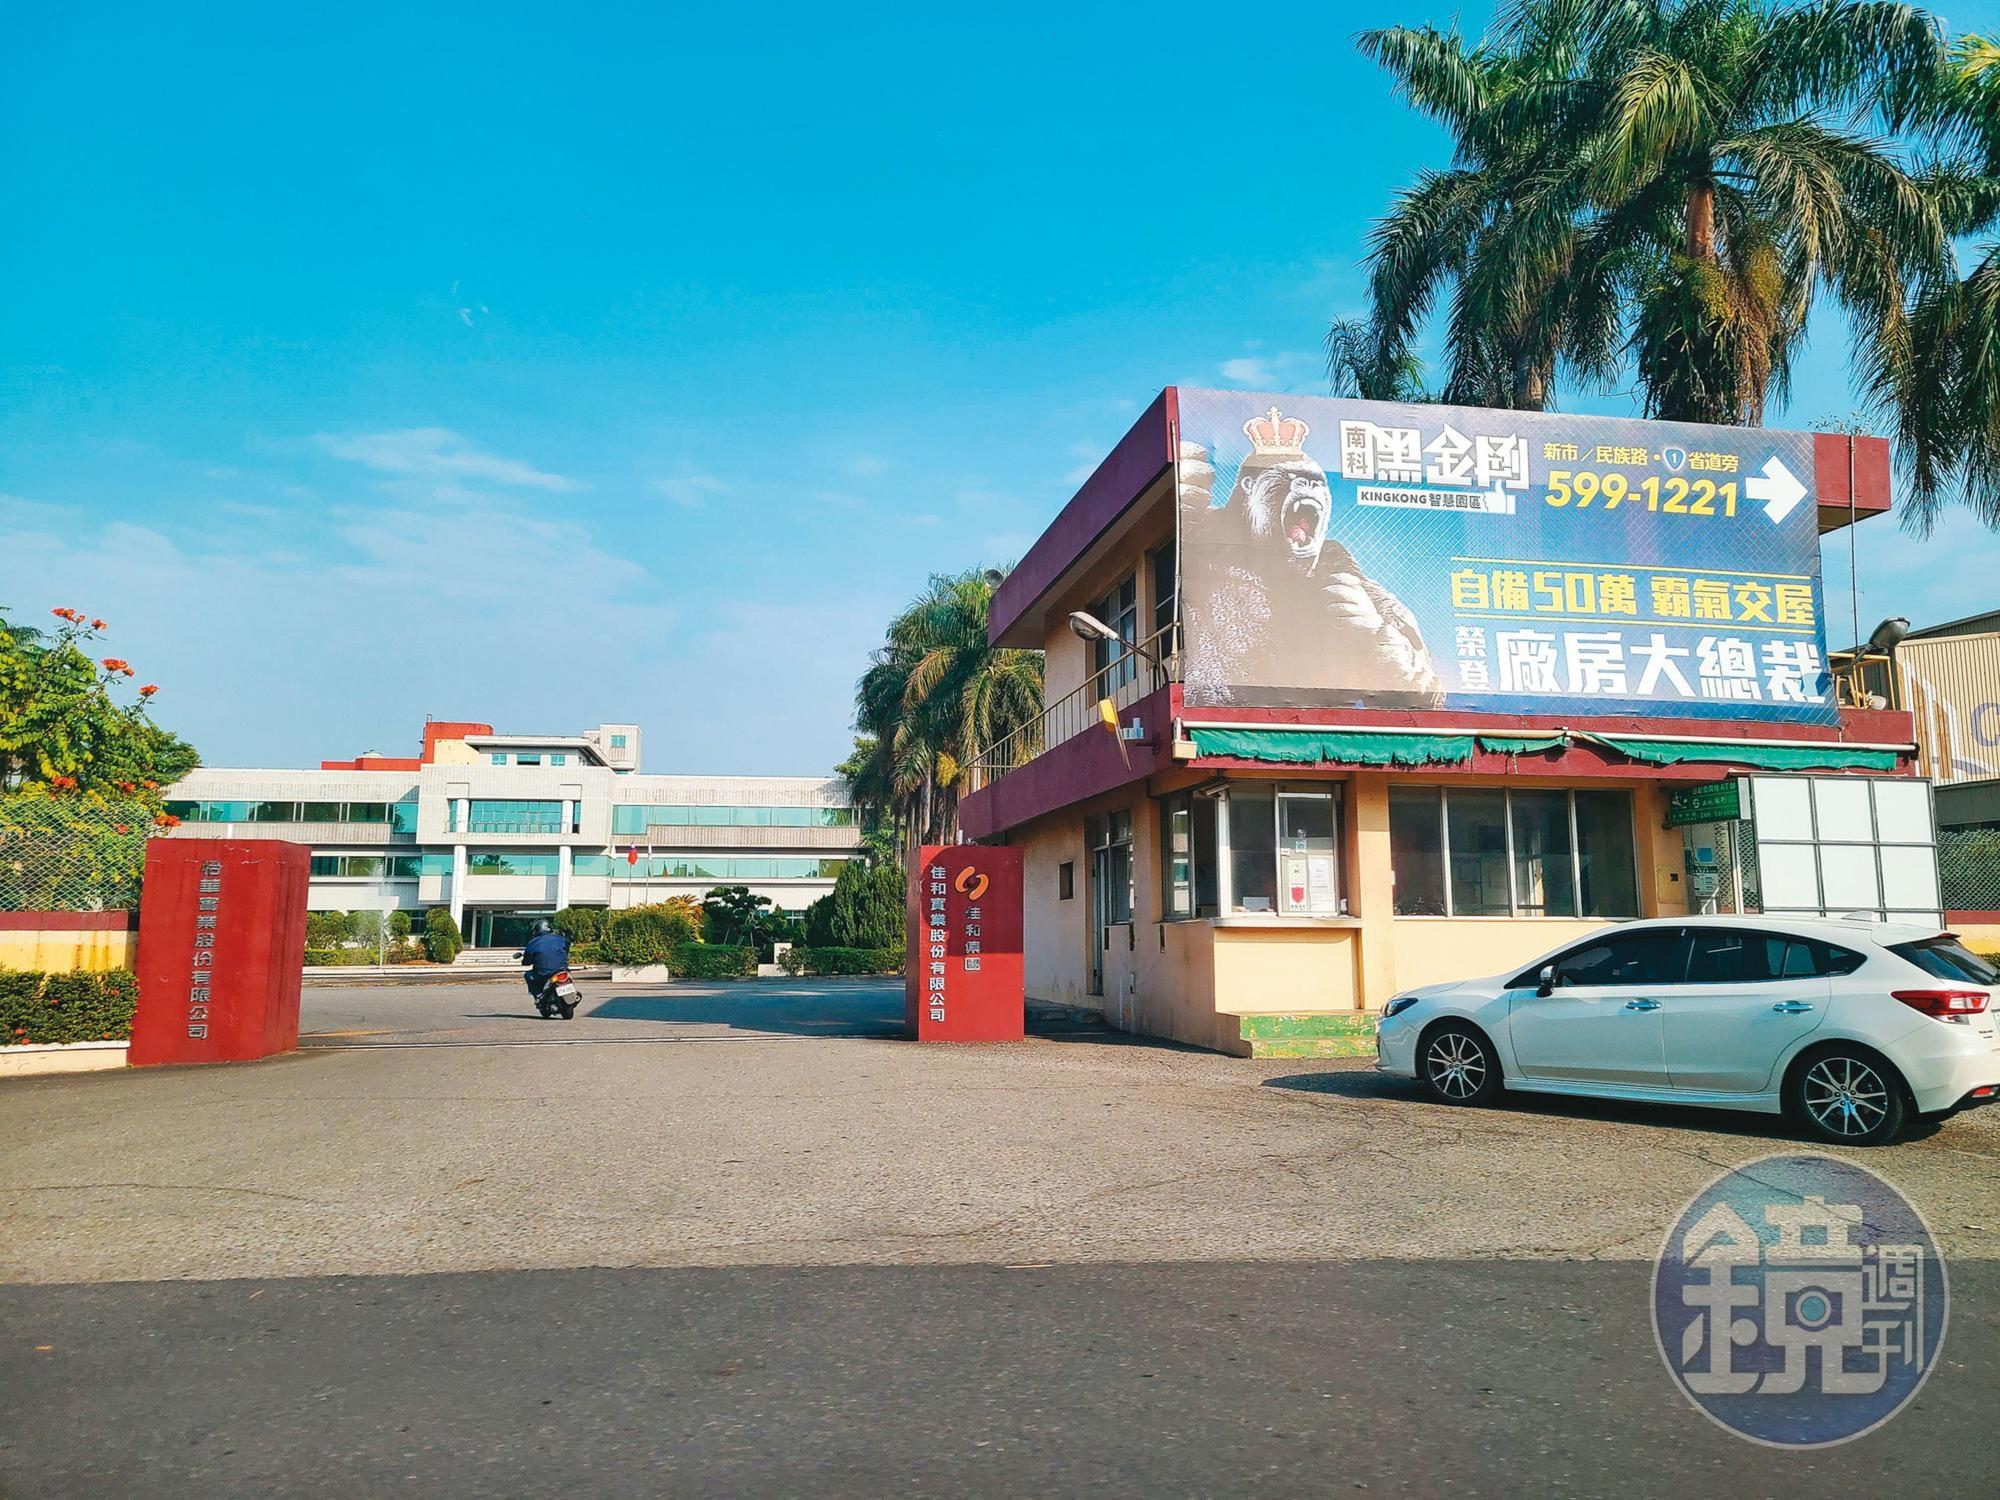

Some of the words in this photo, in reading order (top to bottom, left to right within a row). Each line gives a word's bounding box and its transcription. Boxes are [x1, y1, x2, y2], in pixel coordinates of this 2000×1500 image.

[1345, 426, 1369, 475] 南科
[1375, 423, 1530, 491] 黑金剛
[1689, 452, 1739, 473] 省道旁
[1545, 470, 1737, 517] 599-1221
[1451, 569, 1638, 615] 自備50萬
[1650, 575, 1815, 625] 霸氣交屋
[1455, 626, 1491, 691] 榮登
[1496, 629, 1826, 704] 廠房大總裁
[929, 866, 947, 1022] 佳和實業股份有限公司
[964, 906, 982, 972] 佳和集團
